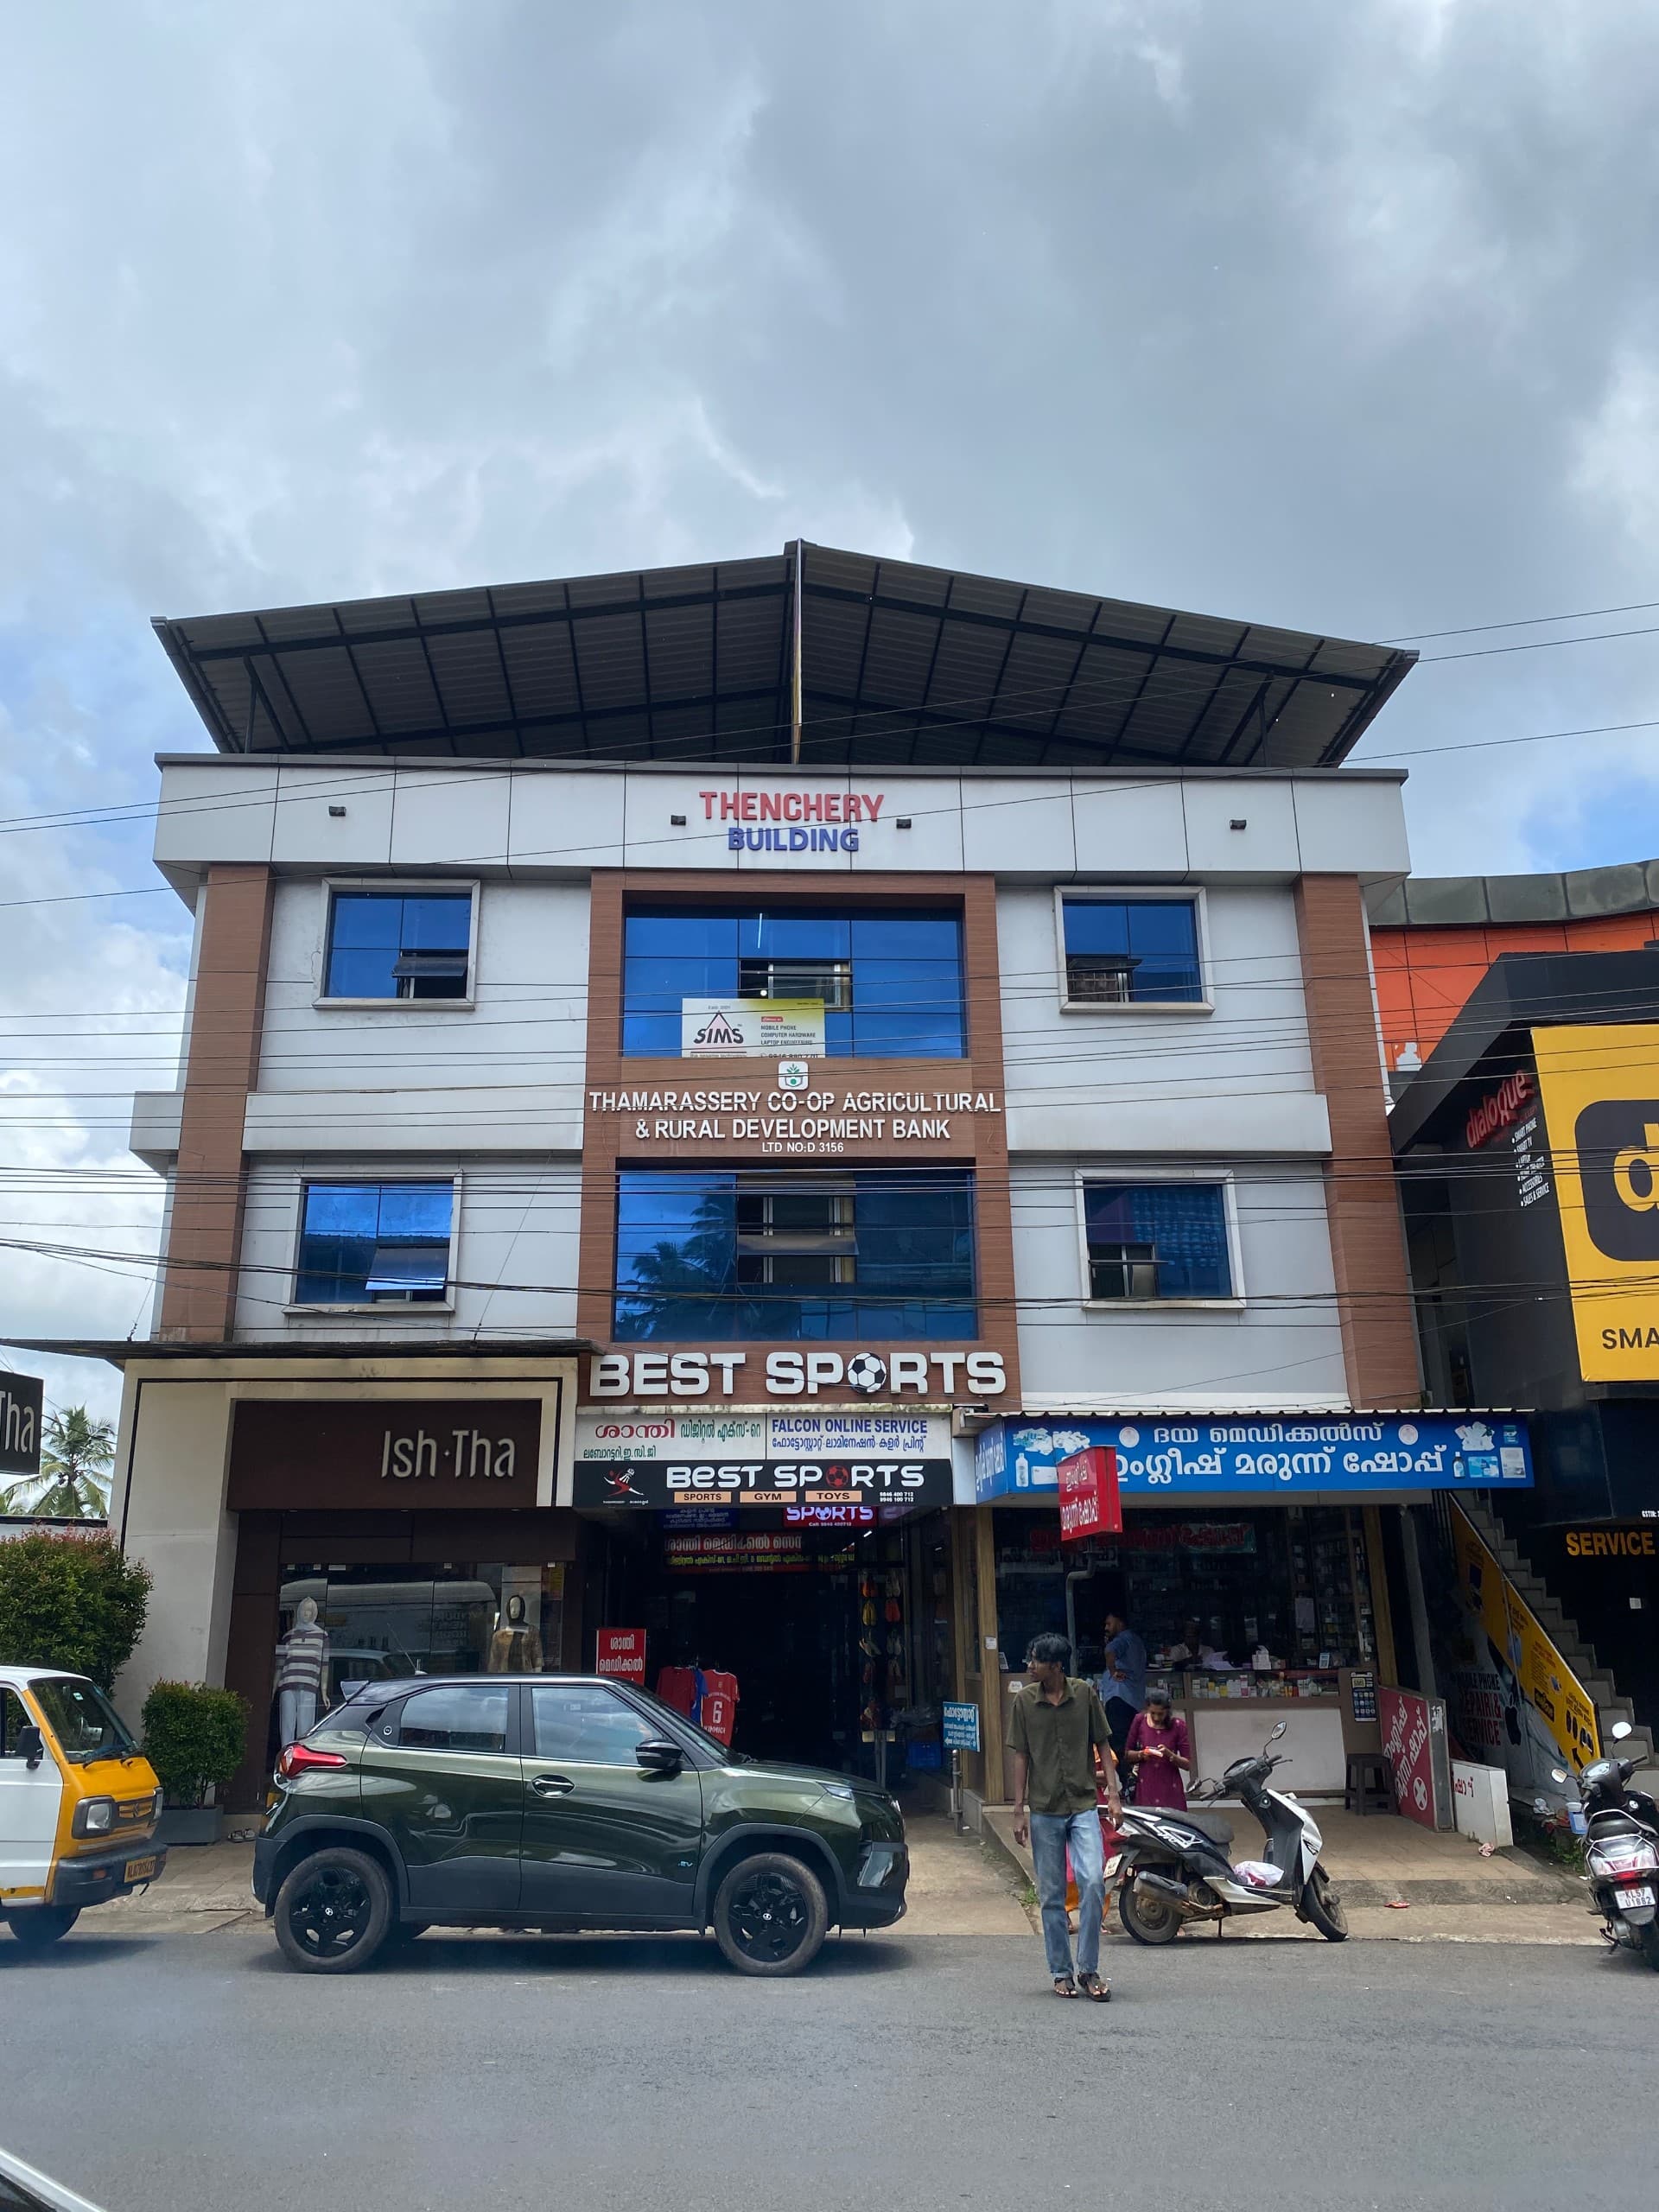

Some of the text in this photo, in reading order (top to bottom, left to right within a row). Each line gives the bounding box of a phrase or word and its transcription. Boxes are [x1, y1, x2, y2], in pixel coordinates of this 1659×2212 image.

[699, 791, 885, 822] THENCHERY
[728, 827, 860, 852] BUILDING
[694, 1028, 744, 1044] SIMS
[589, 1091, 762, 1112] THAMARASSERY
[767, 1091, 836, 1112] CO-OP
[635, 1118, 951, 1140] & RURAL DEVELOPMENT BANK
[762, 1141, 783, 1153] LTD
[819, 1141, 844, 1153] 3156
[590, 1351, 1007, 1397] BEST SPORTS
[595, 1418, 676, 1440] ശാന്തി
[772, 1419, 928, 1433] FALCON ONLINE SERVICE
[1154, 1422, 1386, 1444] ദയ മെഡിക്കൽസ്
[1236, 1446, 1336, 1481] മരുന്ന്
[1343, 1444, 1447, 1473] ഷോപ്പ്
[666, 1465, 925, 1489] BEST SPORTS
[817, 1491, 850, 1500] TOYS
[1566, 1530, 1656, 1556] SERVICE
[610, 1633, 635, 1650] ശാന്തി
[713, 1700, 723, 1724] 6
